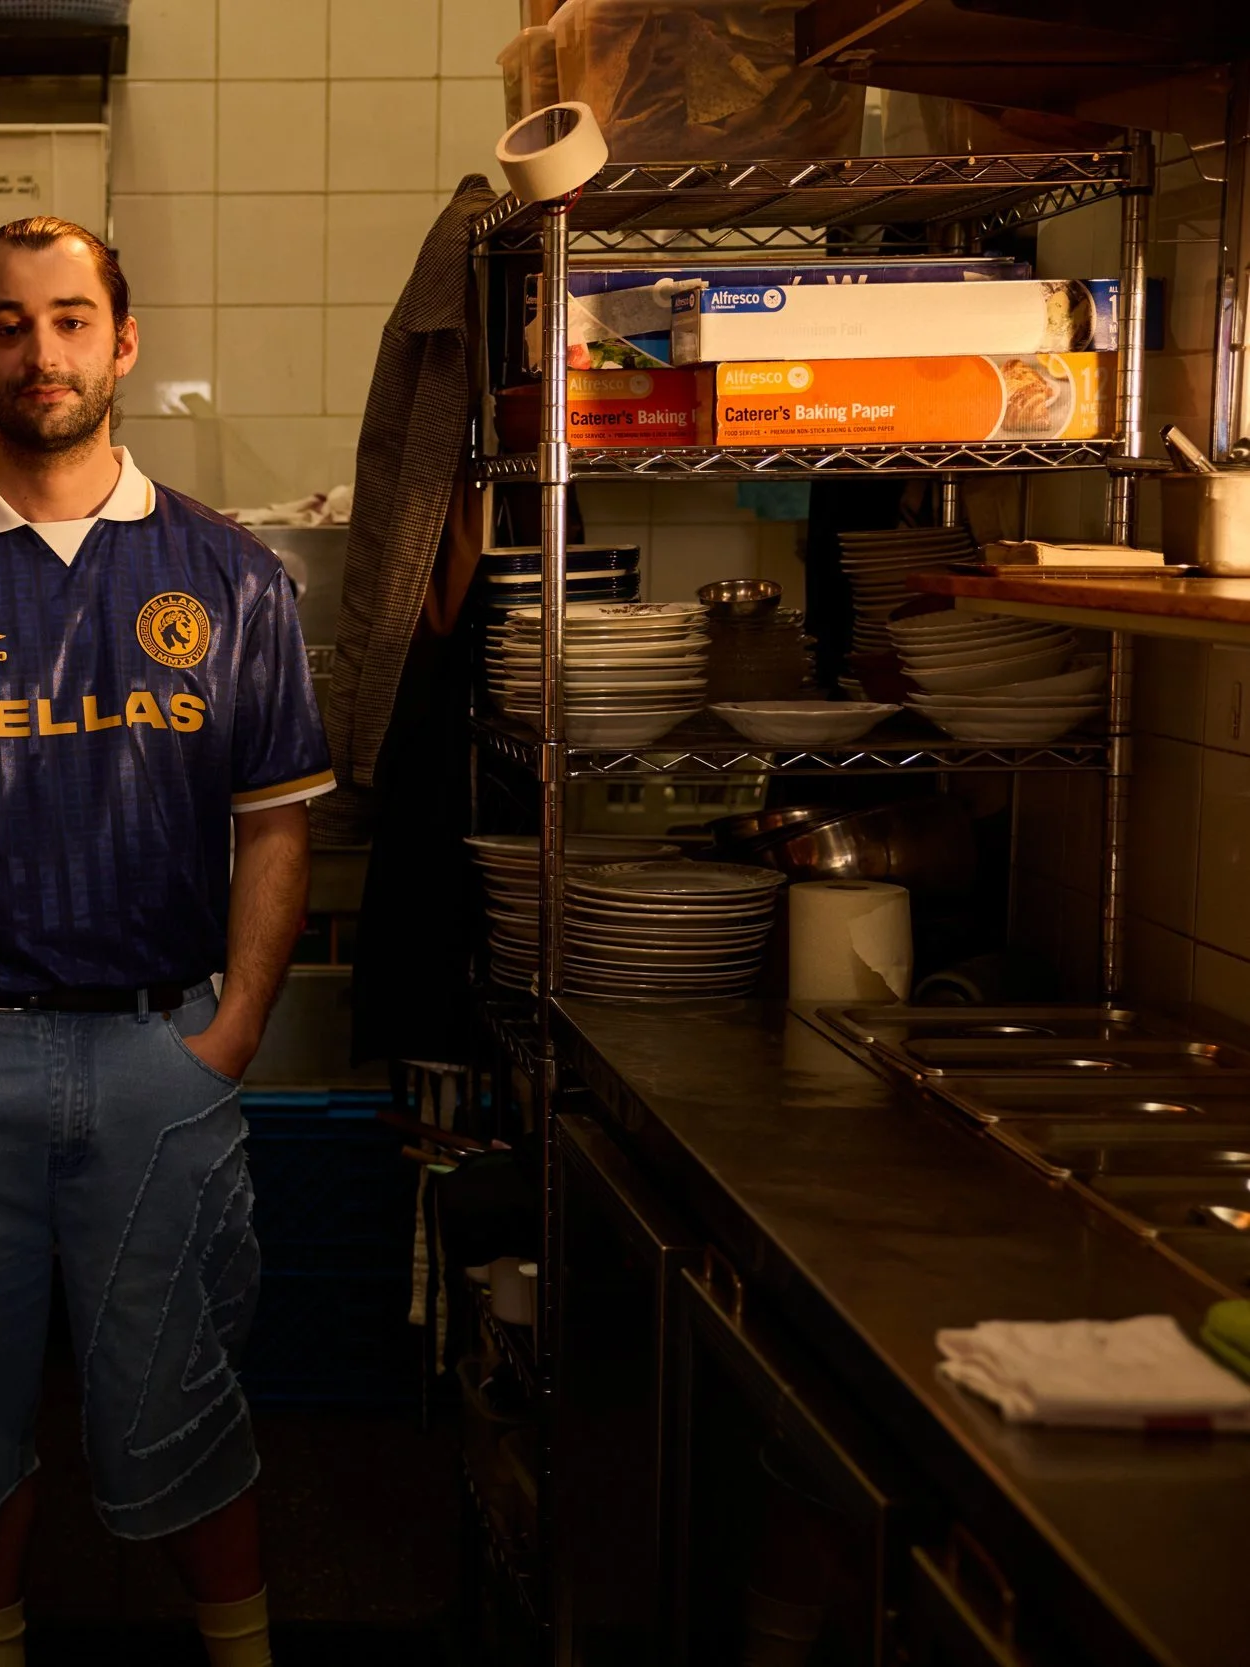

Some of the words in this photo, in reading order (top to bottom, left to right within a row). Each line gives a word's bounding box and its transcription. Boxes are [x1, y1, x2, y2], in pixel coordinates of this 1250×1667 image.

[711, 291, 760, 305] Alfresco
[570, 376, 624, 391] Alfresco
[725, 369, 783, 385] Alfresco
[570, 410, 633, 425] Caterer's
[638, 409, 687, 426] Baking
[725, 405, 791, 422] Caterer's
[795, 403, 847, 422] Baking
[852, 403, 896, 421] Paper
[144, 595, 197, 619] HELLAS
